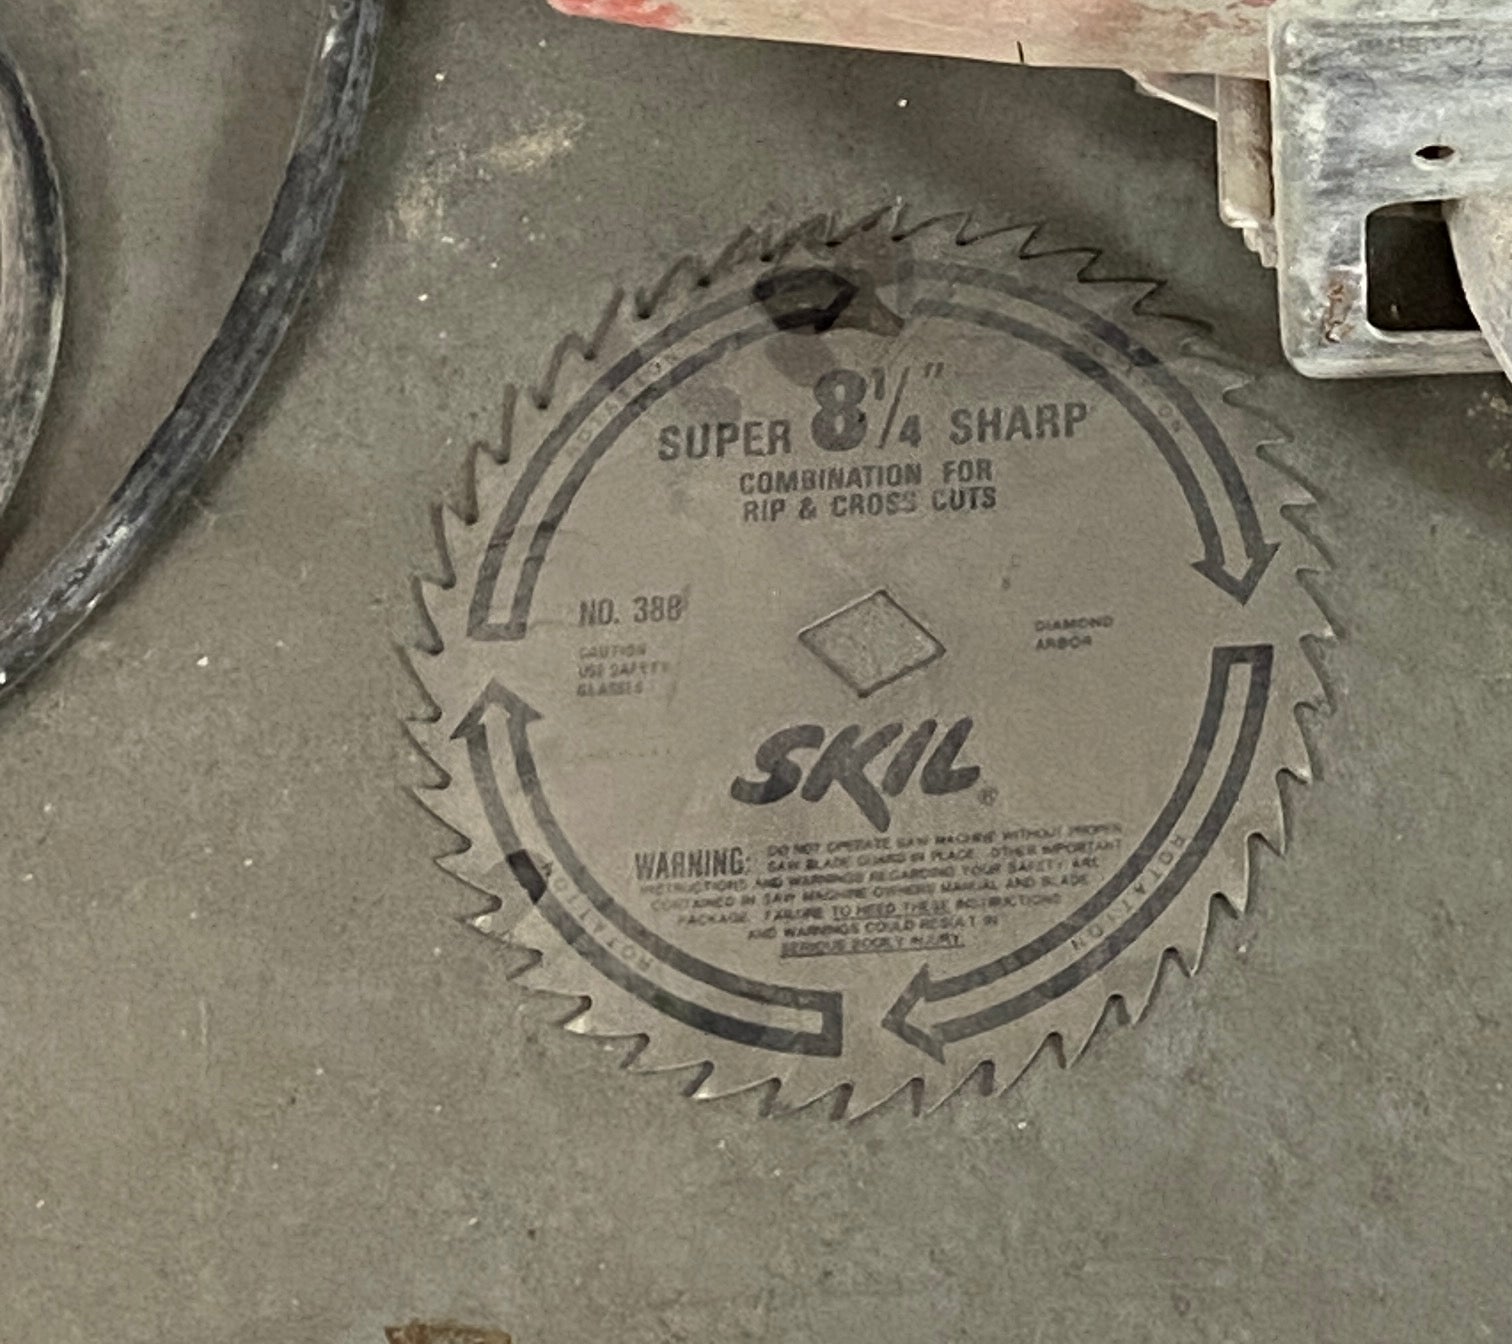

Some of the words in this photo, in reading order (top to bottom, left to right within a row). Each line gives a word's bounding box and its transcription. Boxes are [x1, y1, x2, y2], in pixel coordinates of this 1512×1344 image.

[657, 419, 792, 461] SUPER
[949, 402, 1089, 445] SHARP
[739, 463, 922, 495] COMBINATION
[942, 459, 993, 483] FOR
[743, 498, 786, 522] RIP
[798, 496, 817, 519] &
[830, 491, 917, 518] CROSS
[932, 487, 996, 511] CUTS
[579, 598, 620, 627] NO.
[1035, 615, 1114, 632] DIAMOND
[731, 716, 981, 833] SKIL
[635, 846, 751, 880] WARNING:
